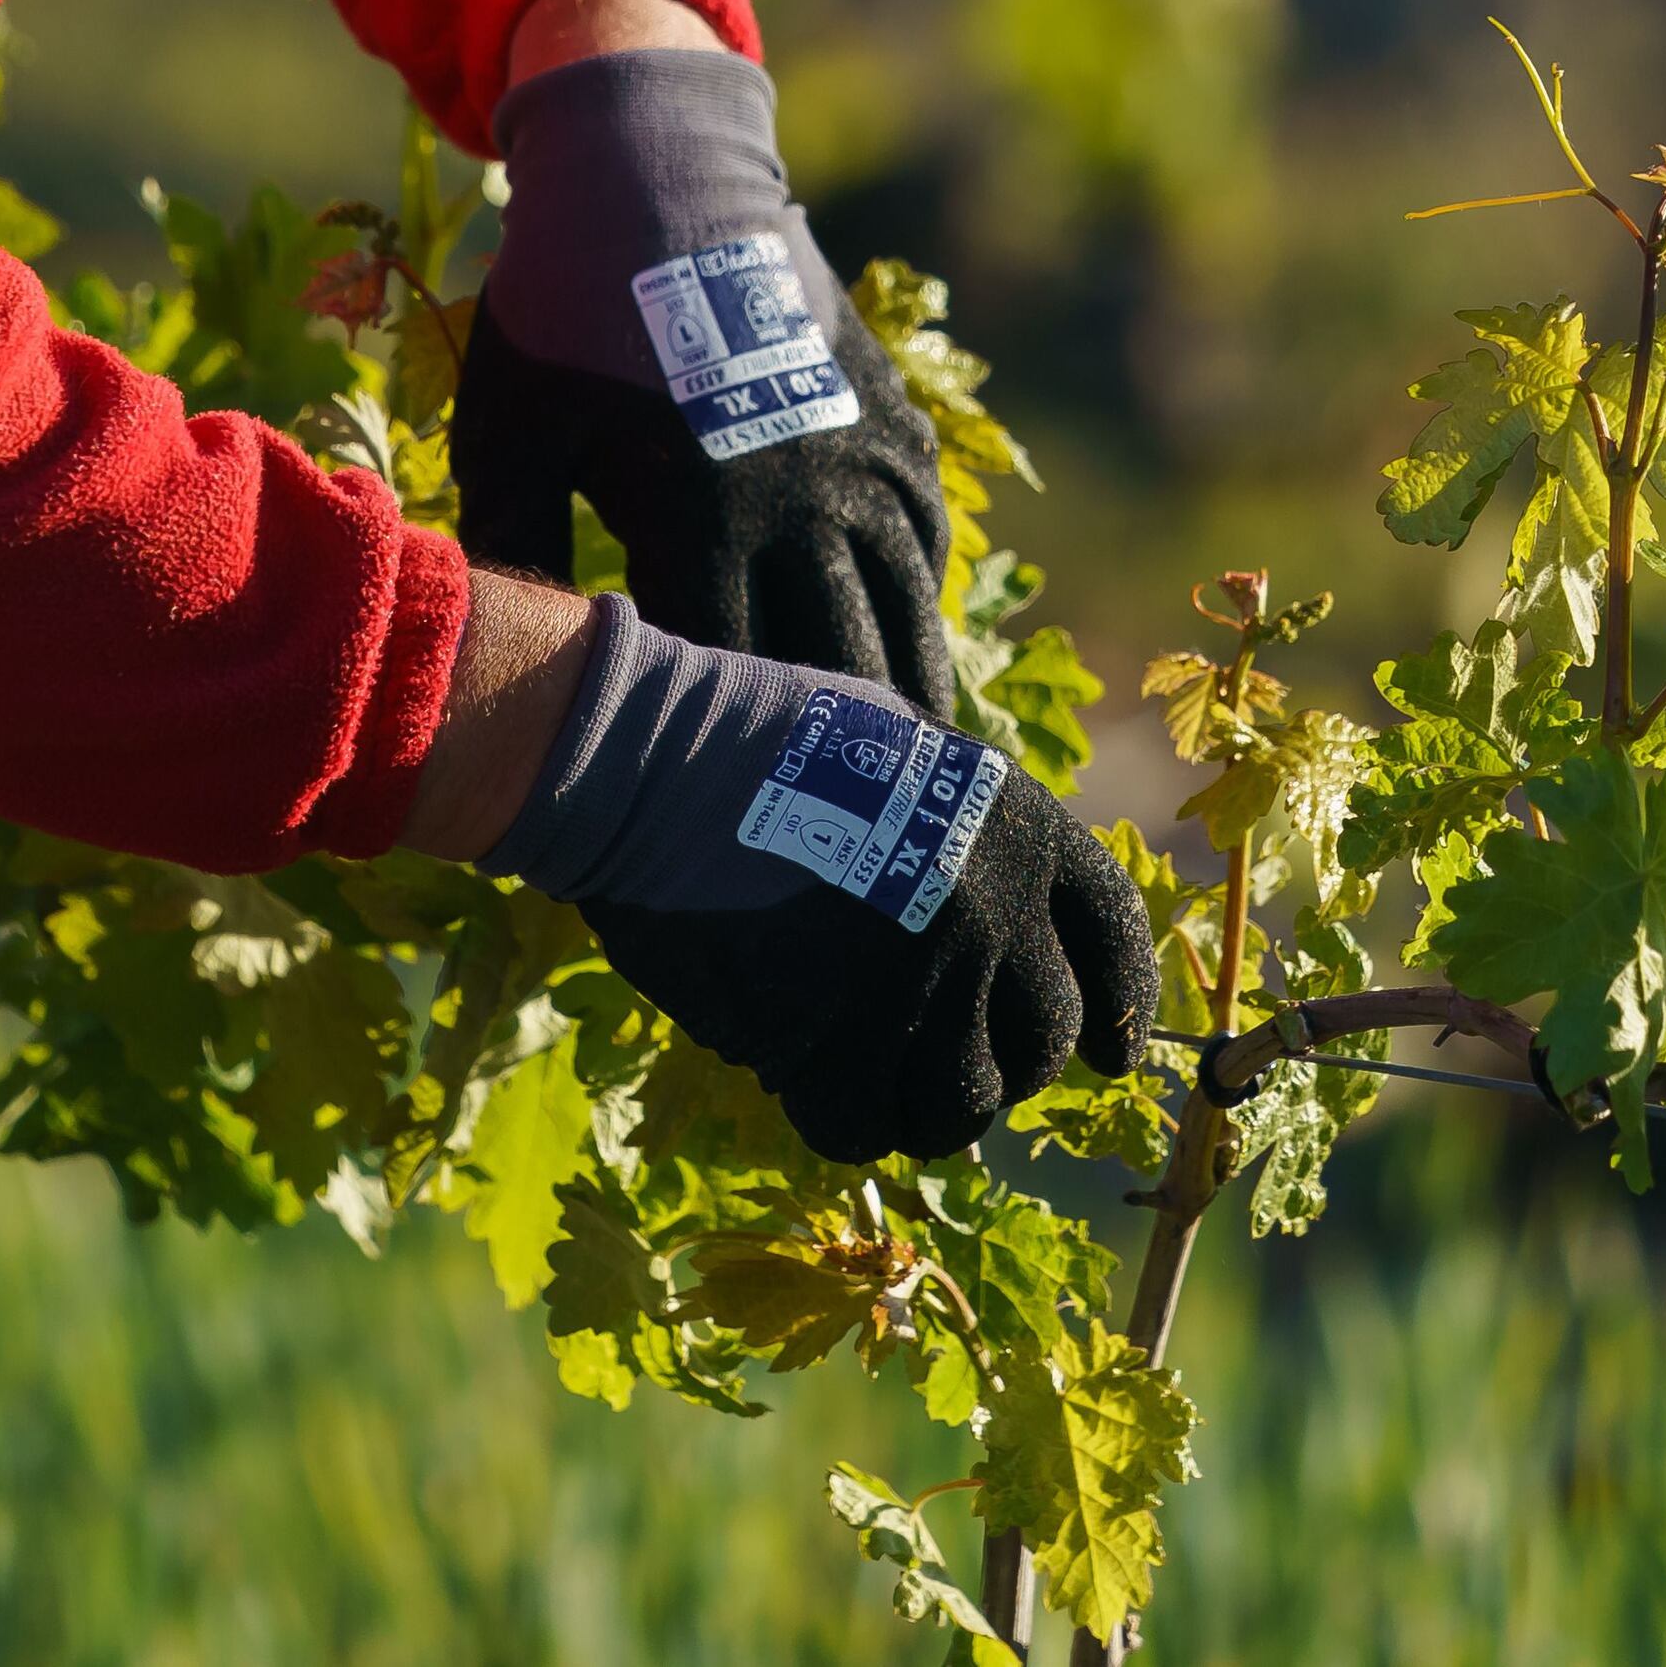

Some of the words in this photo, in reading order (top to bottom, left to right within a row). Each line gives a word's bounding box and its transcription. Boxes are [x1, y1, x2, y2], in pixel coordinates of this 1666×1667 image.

[712, 385, 760, 417] XL
[932, 767, 964, 802] 10
[783, 814, 802, 835] CUT
[812, 832, 832, 846] 1
[853, 839, 885, 885] A353
[887, 839, 929, 878] XL
